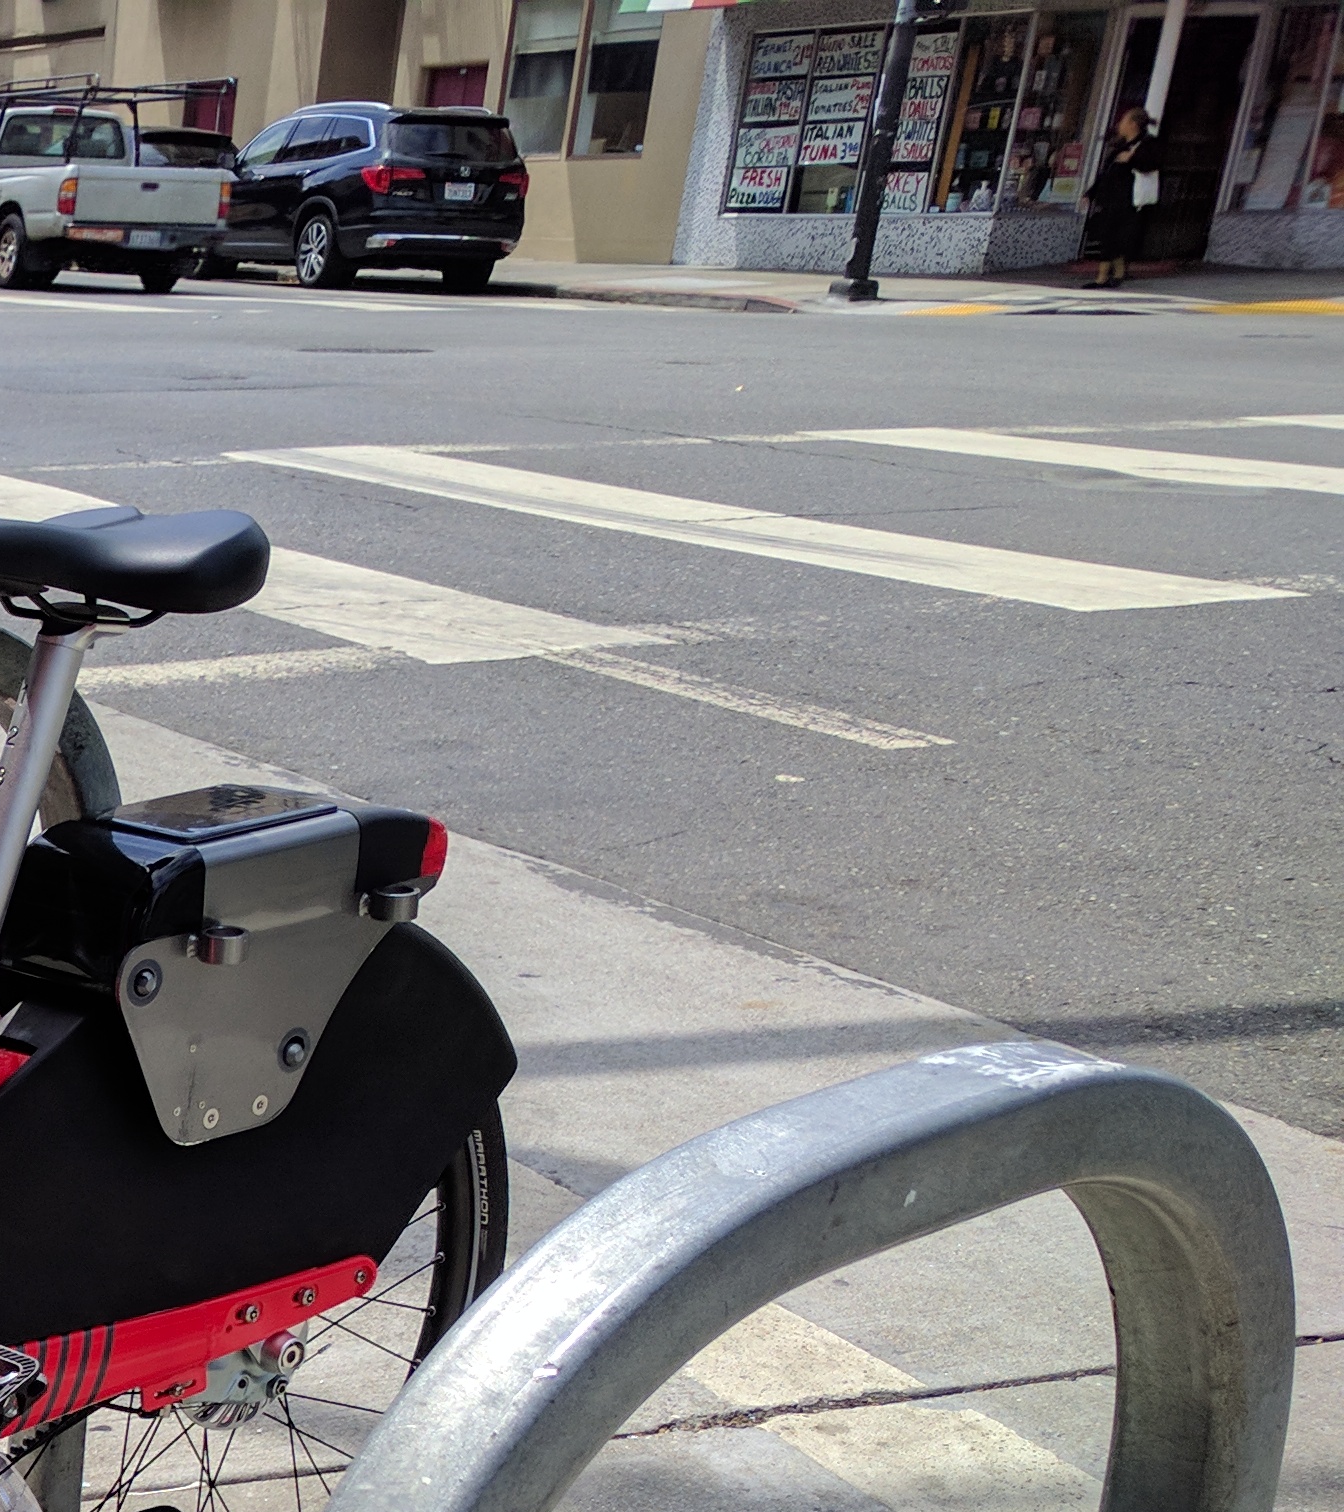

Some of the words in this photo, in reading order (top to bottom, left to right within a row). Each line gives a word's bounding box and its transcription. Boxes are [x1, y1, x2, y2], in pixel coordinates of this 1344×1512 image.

[905, 76, 945, 100] BALLS
[804, 124, 855, 142] ITALIAN
[801, 144, 838, 162] TUNA
[739, 170, 783, 188] FRESH
[886, 171, 925, 194] RKEY
[728, 188, 756, 205] PIZZA
[6, 725, 19, 748] 2
[472, 1129, 489, 1225] MARATHON
